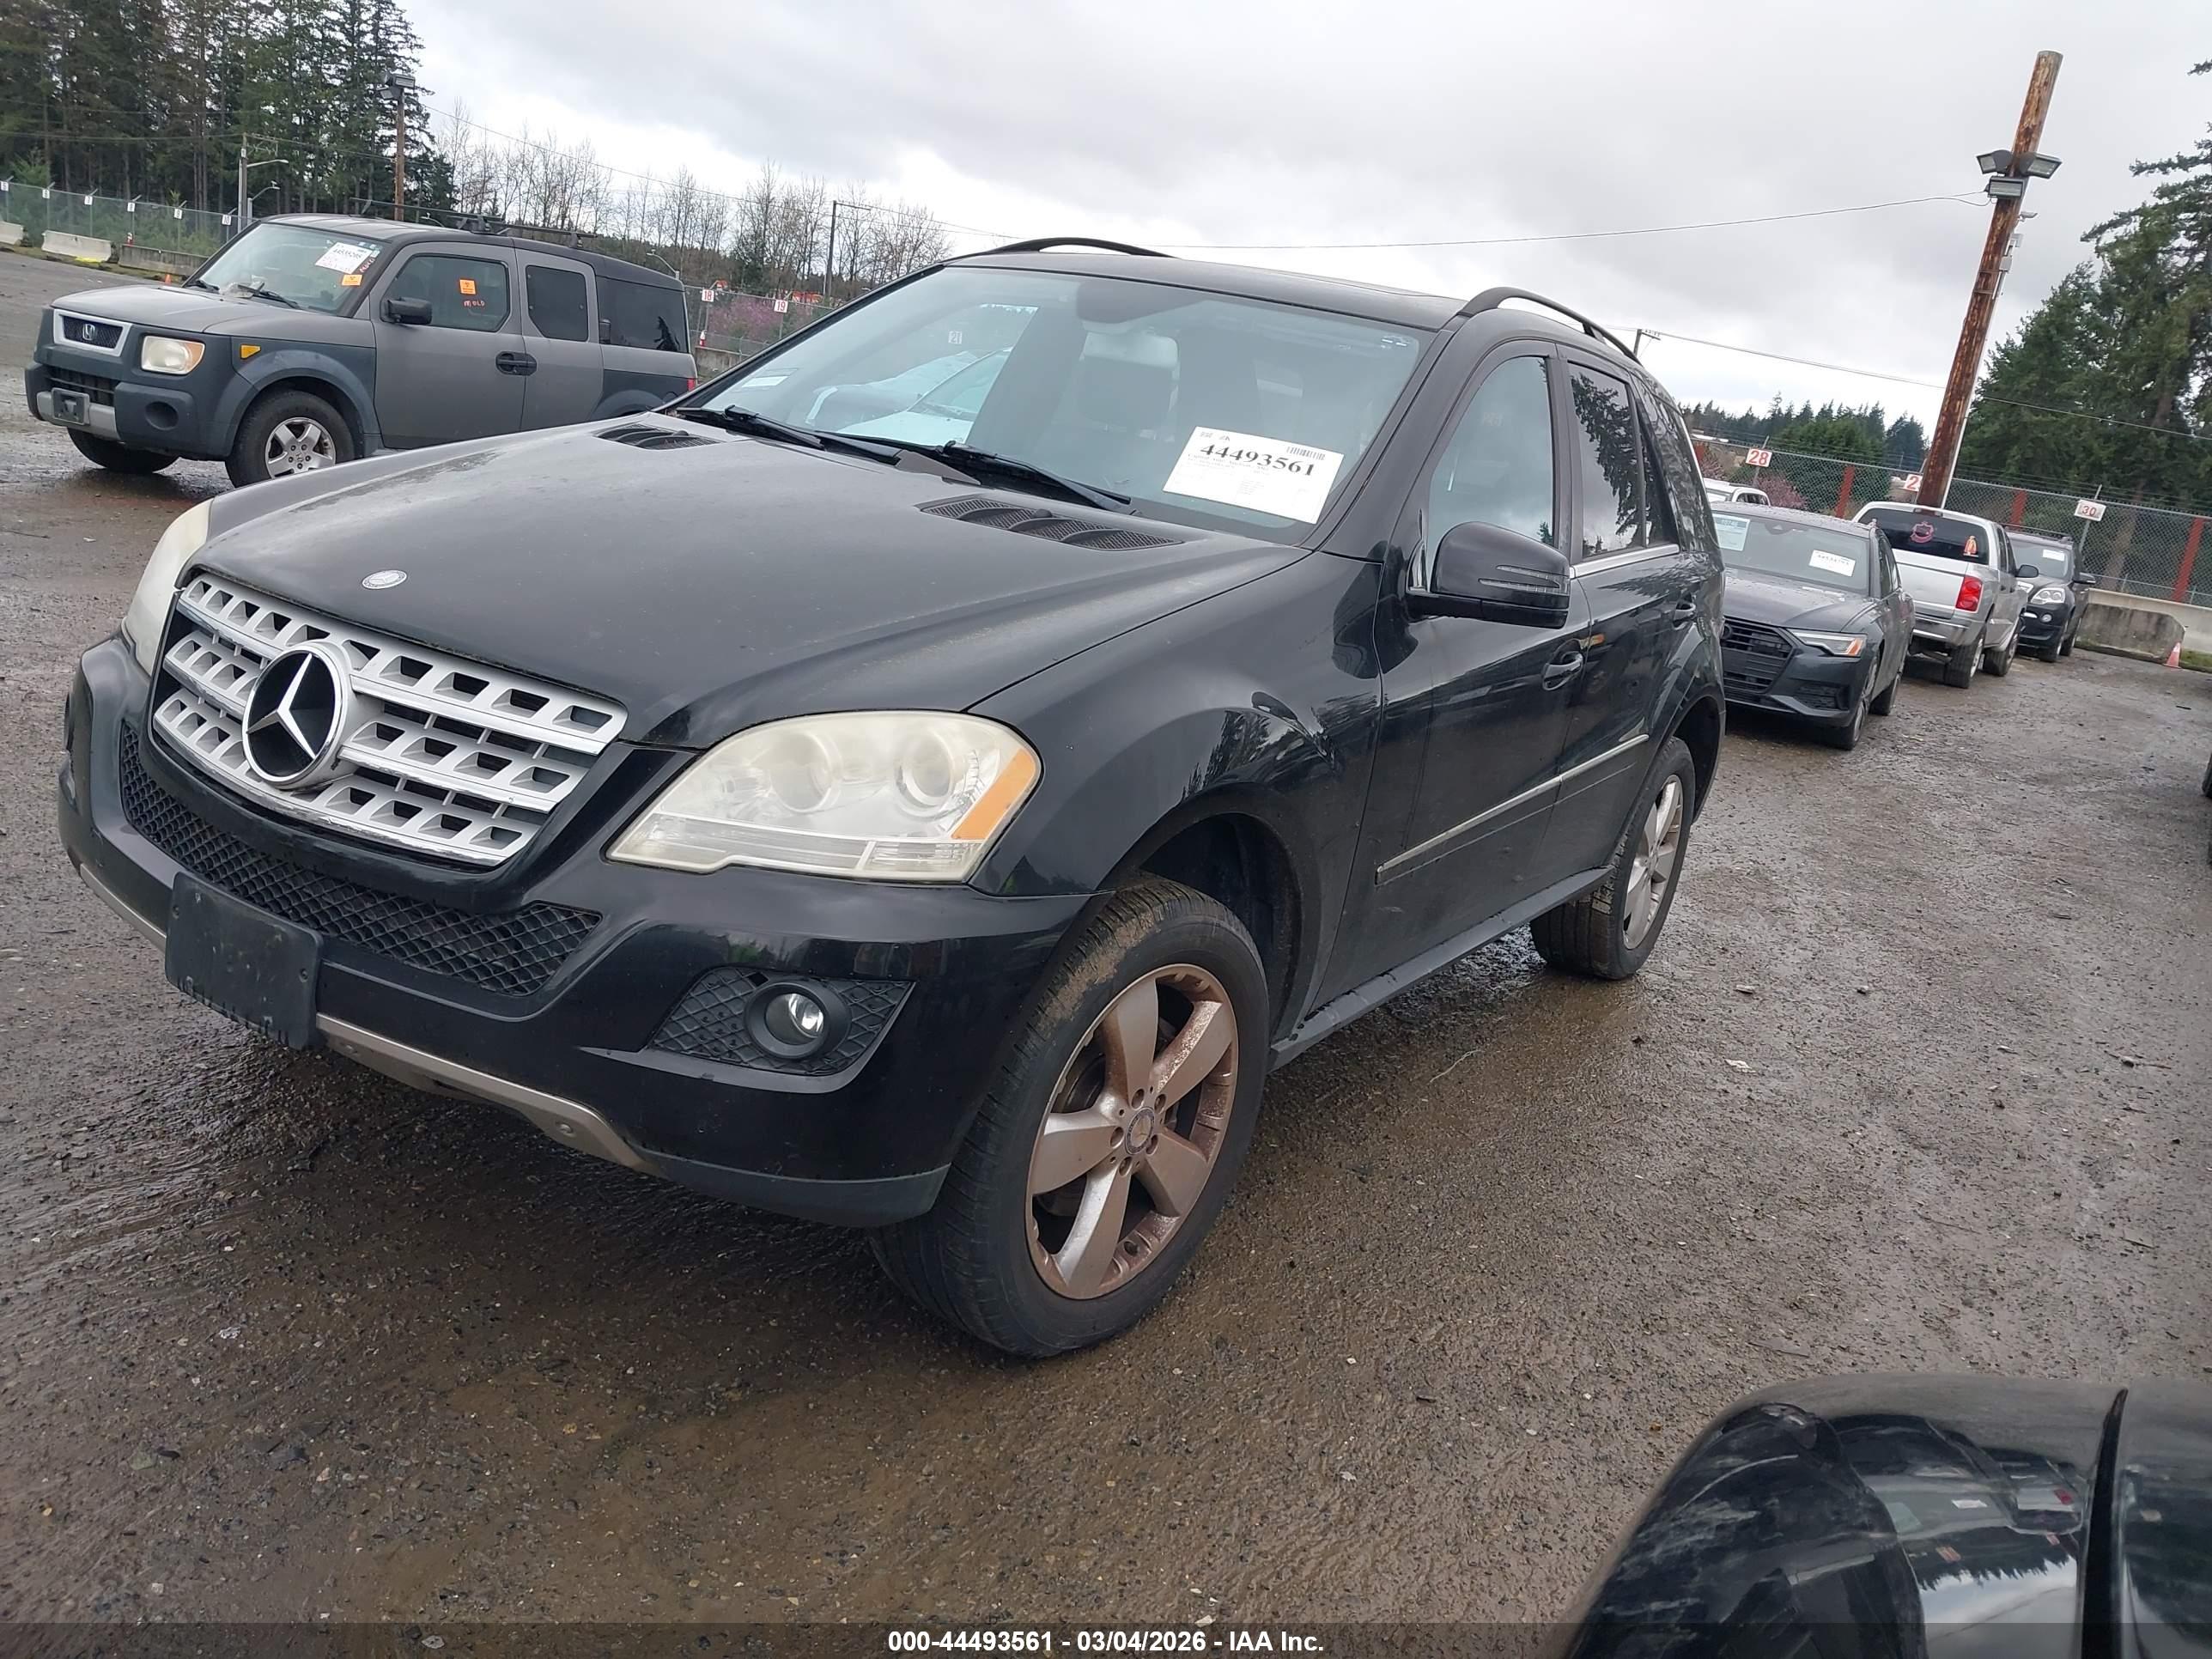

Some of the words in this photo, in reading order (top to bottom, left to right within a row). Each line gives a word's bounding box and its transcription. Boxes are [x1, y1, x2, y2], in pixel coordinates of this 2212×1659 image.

[704, 290, 712, 301] 18
[777, 301, 786, 312] 19
[1200, 444, 1314, 476] 44493561
[1748, 450, 1769, 465] 28
[2082, 505, 2097, 516] 30
